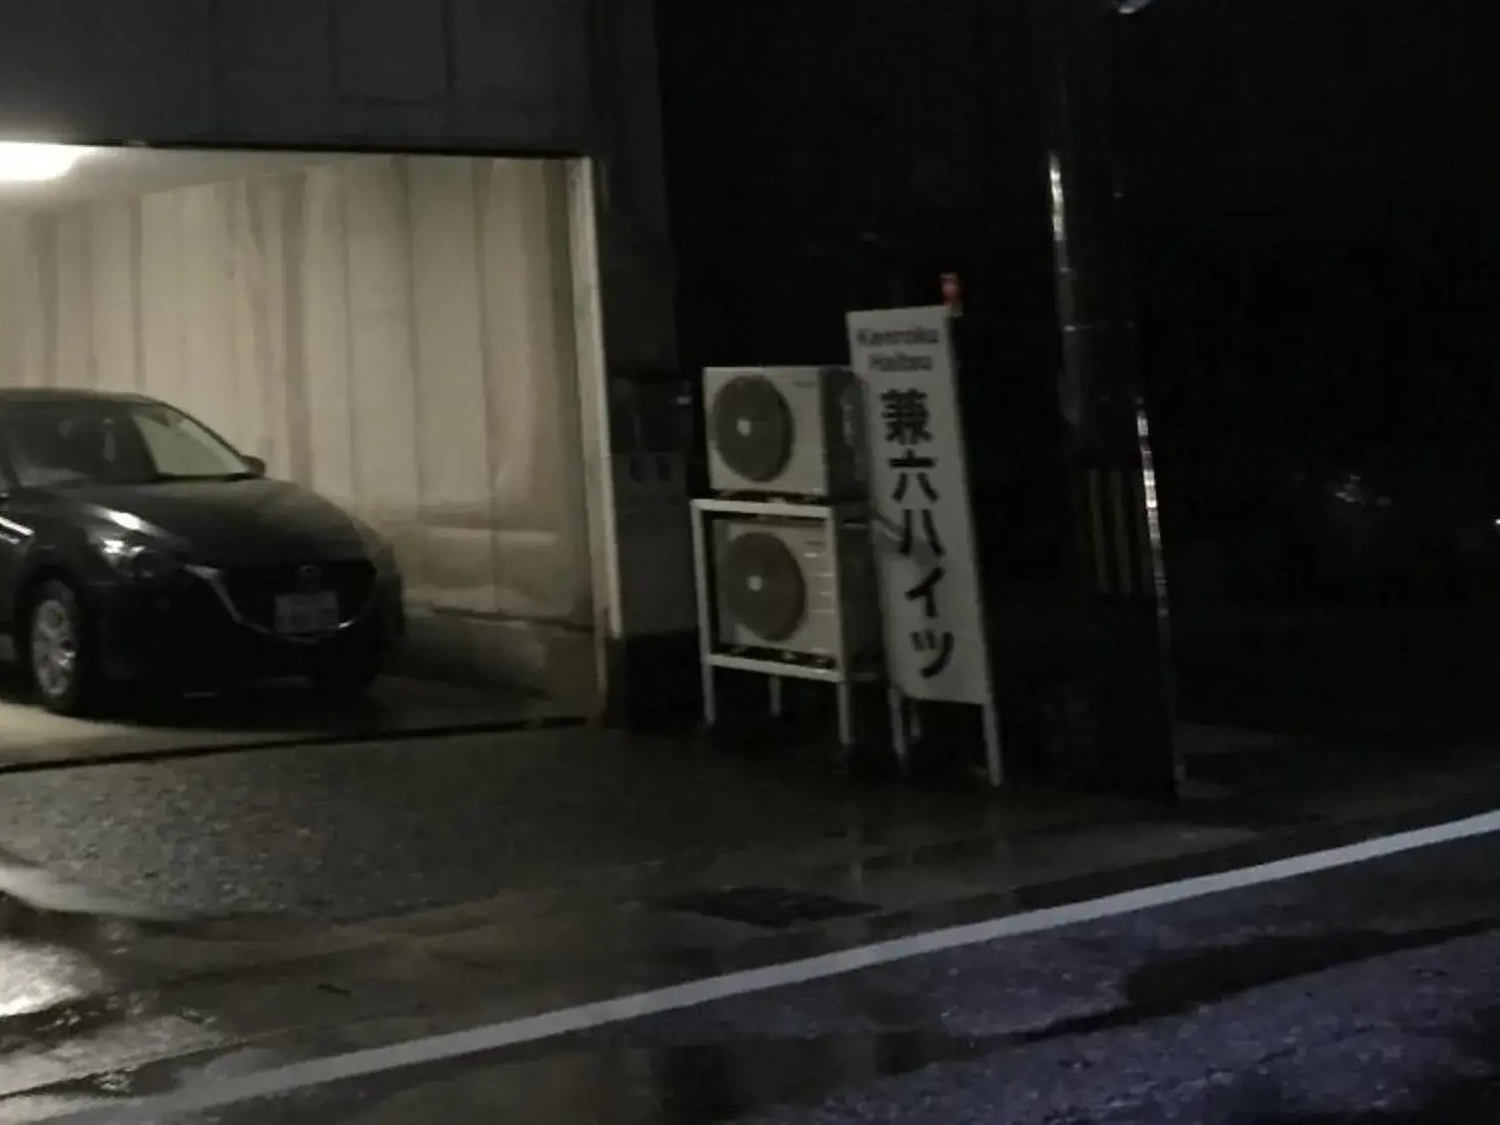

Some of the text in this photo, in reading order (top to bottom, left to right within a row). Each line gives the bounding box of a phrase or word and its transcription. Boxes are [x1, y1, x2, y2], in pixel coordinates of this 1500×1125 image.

[880, 388, 954, 678] 兼六ハイツ
